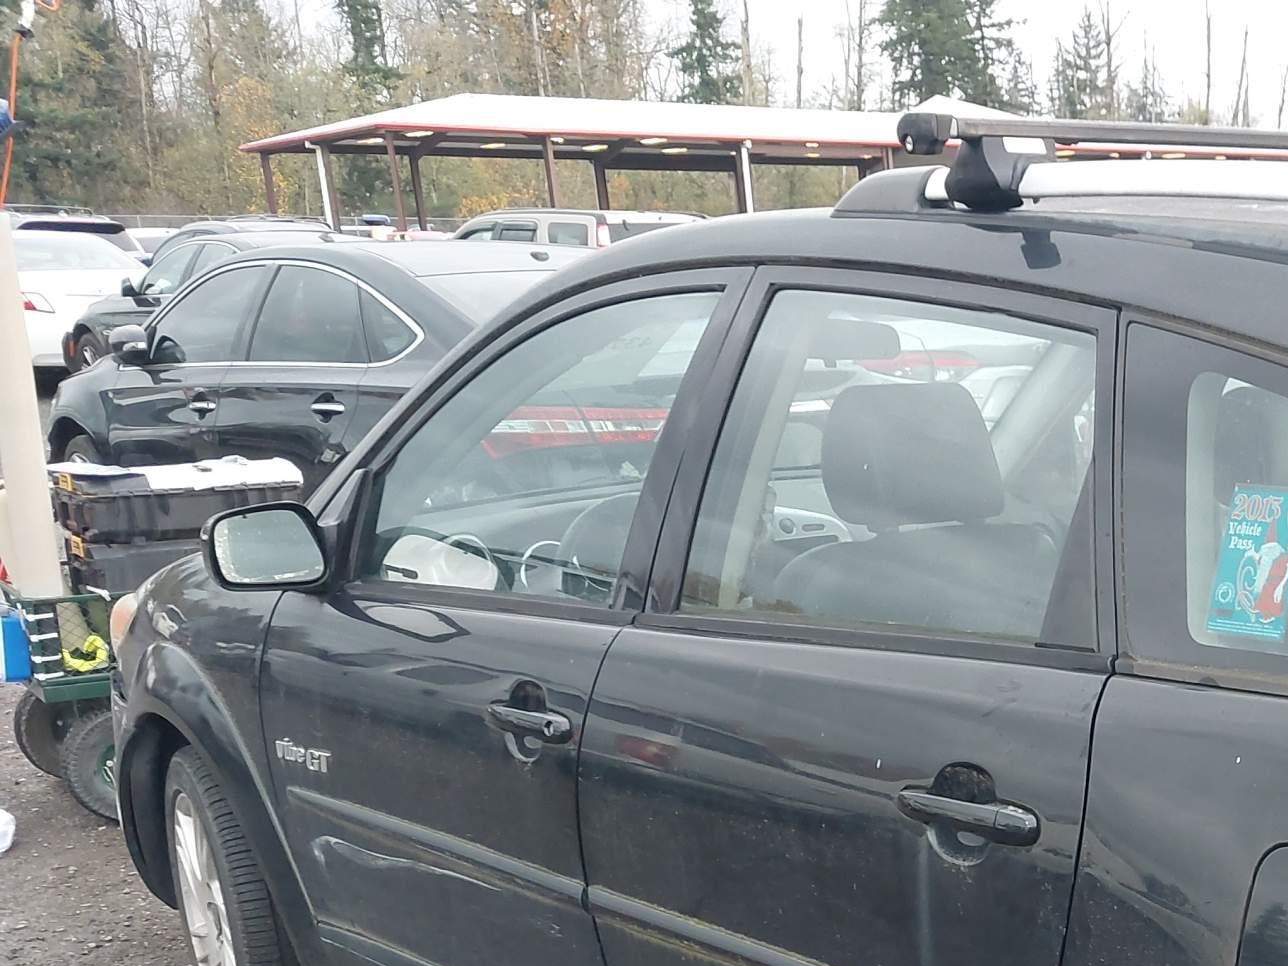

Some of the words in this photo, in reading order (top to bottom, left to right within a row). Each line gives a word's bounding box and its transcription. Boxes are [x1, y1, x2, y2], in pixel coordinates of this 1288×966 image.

[1228, 521, 1262, 537] Vehicle
[1229, 535, 1254, 549] Pass
[306, 748, 331, 773] GT
